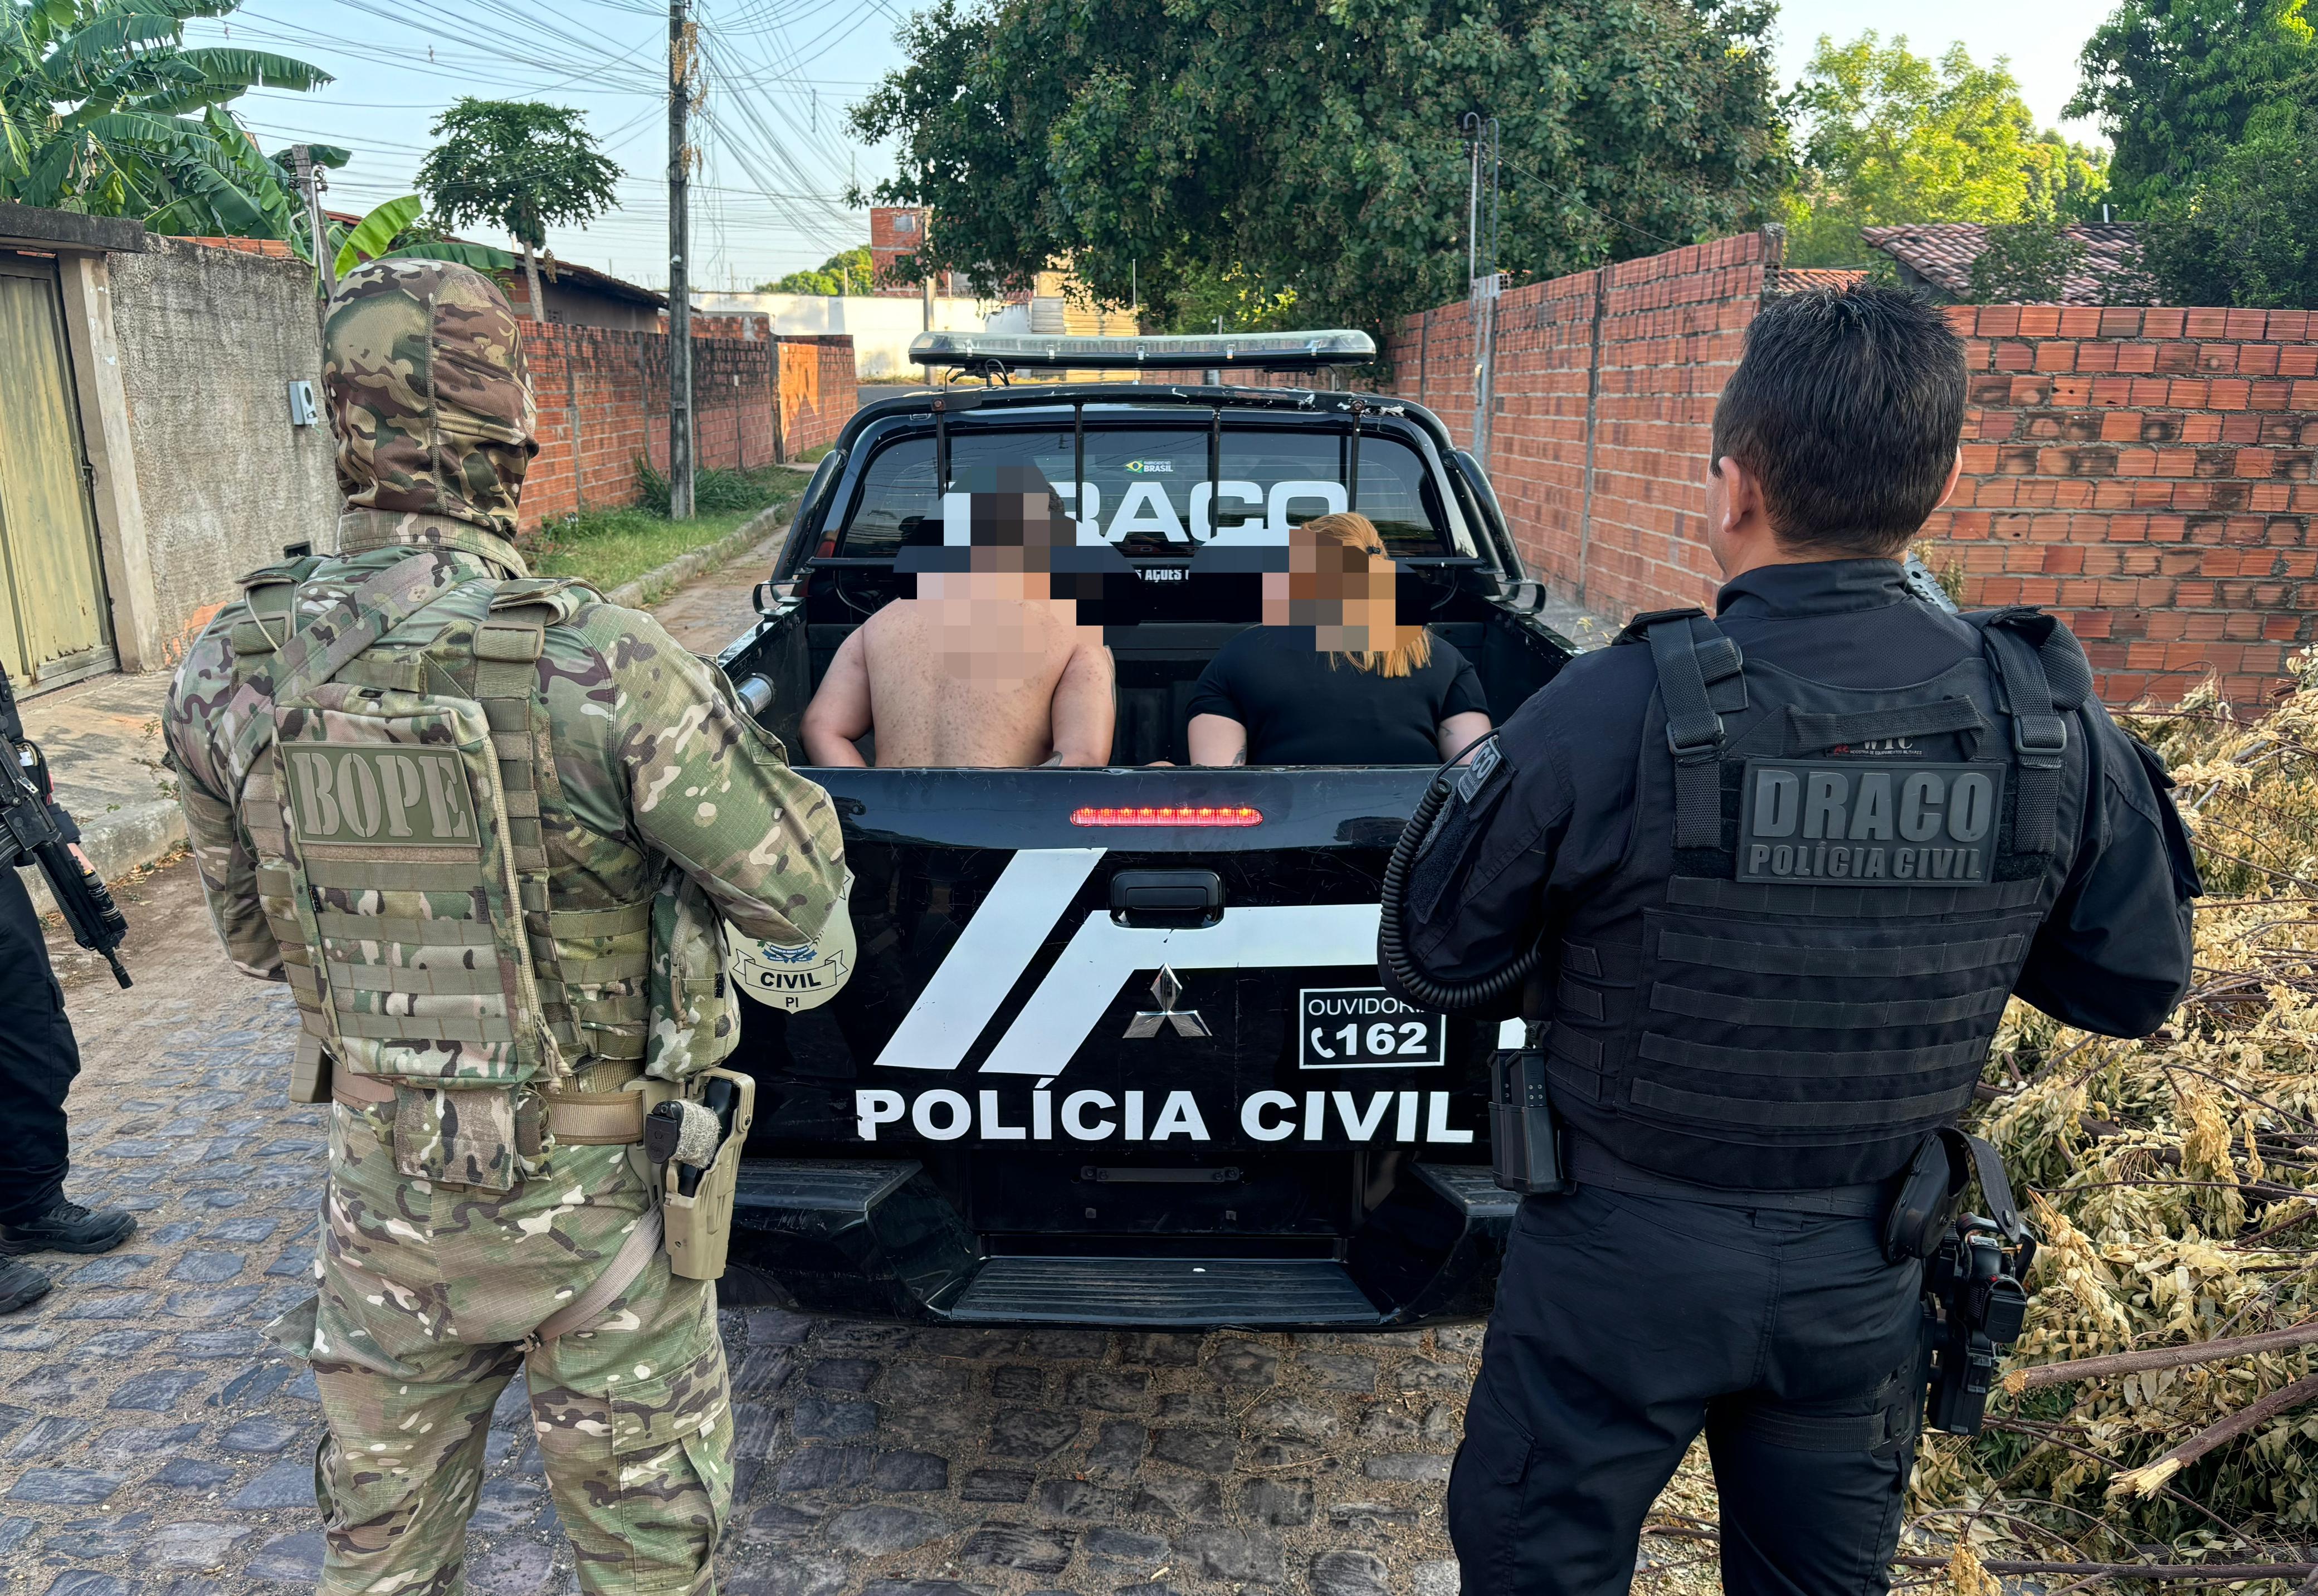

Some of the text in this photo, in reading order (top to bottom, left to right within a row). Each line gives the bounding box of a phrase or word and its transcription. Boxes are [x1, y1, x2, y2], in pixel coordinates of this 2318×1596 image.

[944, 481, 1348, 543] RACO
[291, 753, 470, 838] BOPE
[1753, 770, 1993, 842] DRACO
[1749, 841, 1980, 878] POLÍCIA CIVIL
[760, 972, 821, 988] CIVIL
[785, 997, 798, 1008] PI
[1309, 997, 1424, 1016] OUVIDOR
[1336, 1022, 1427, 1055] 162
[856, 1078, 1473, 1143] POLÍCIA CIVIL
